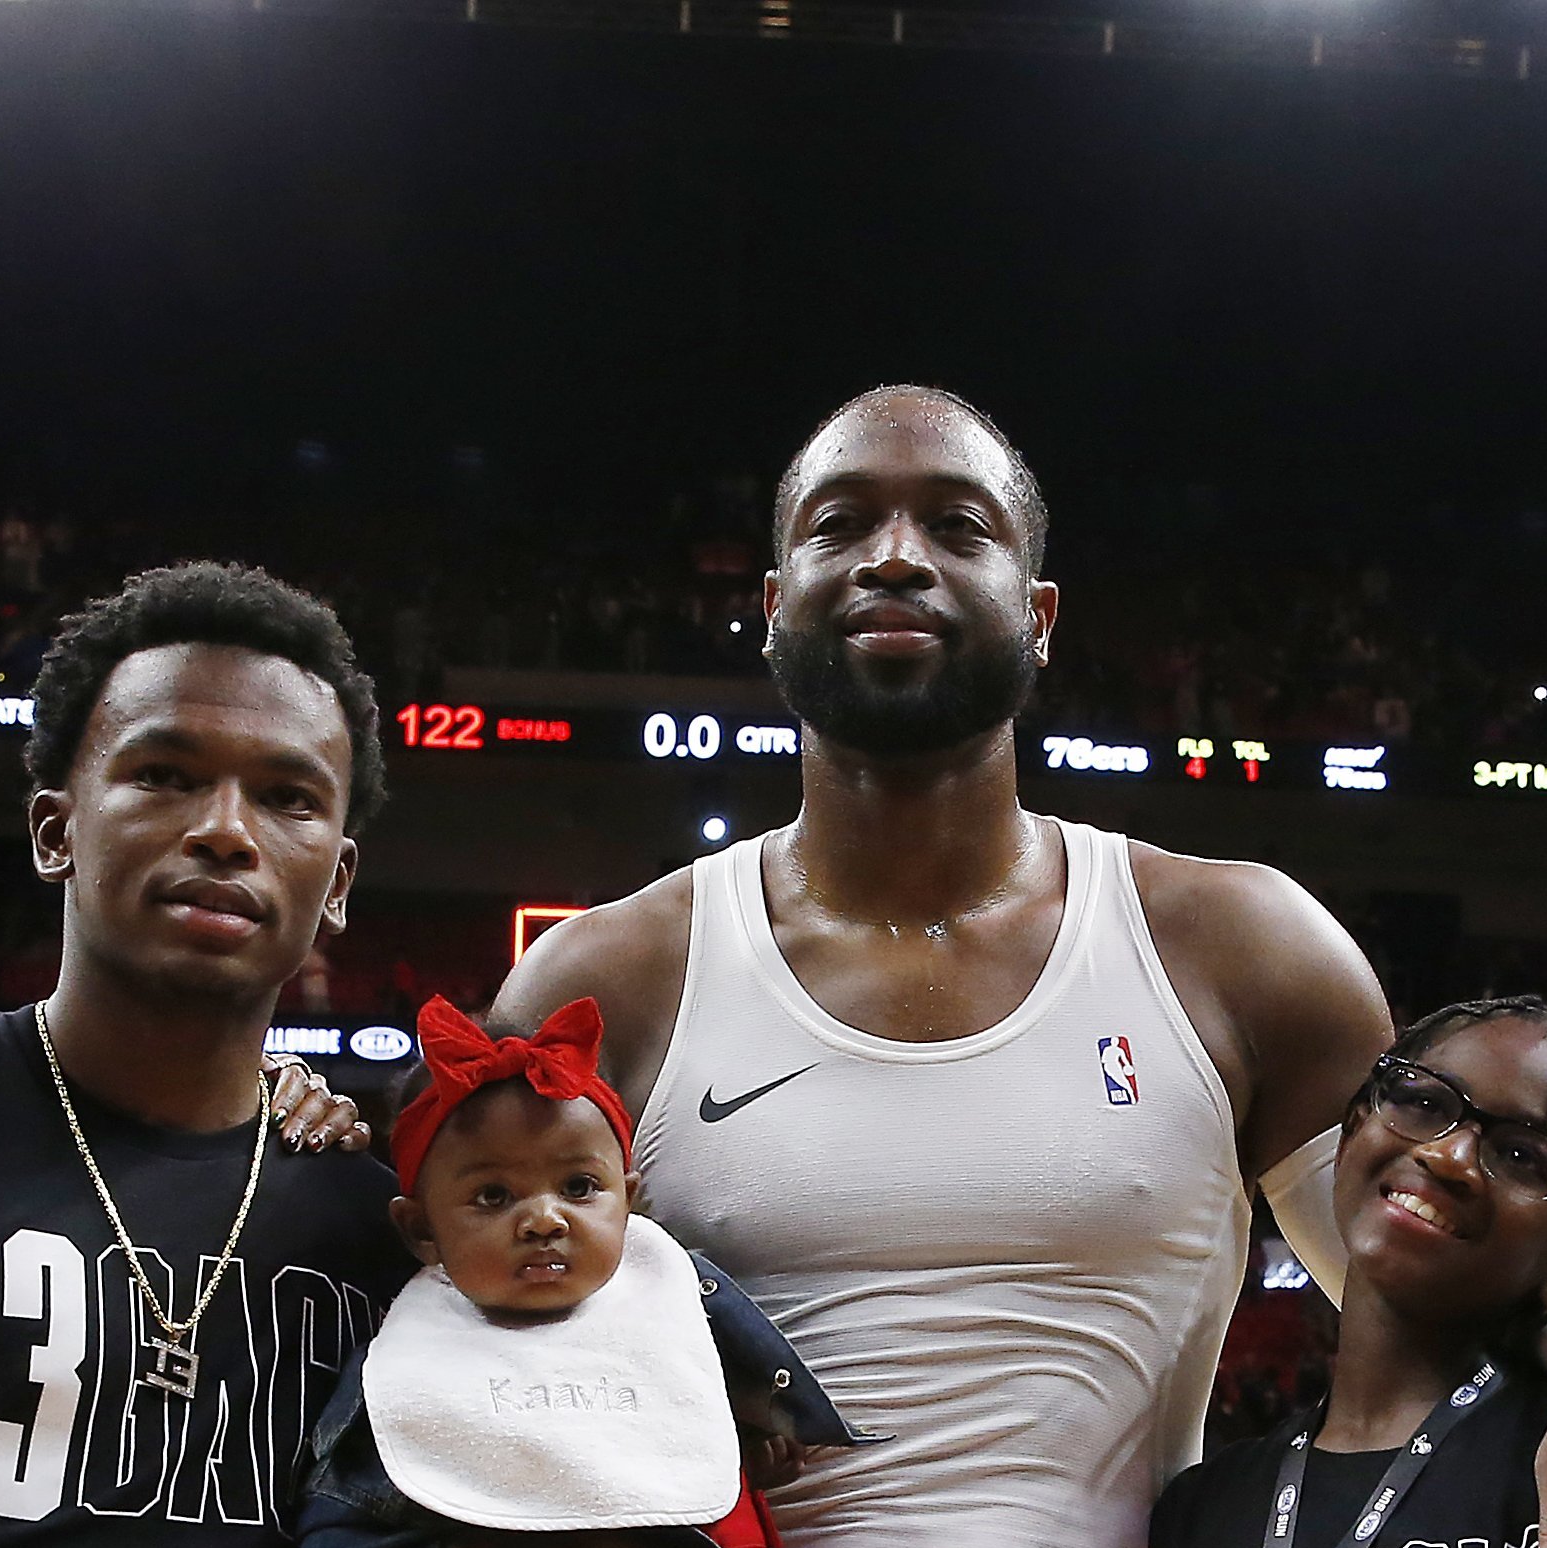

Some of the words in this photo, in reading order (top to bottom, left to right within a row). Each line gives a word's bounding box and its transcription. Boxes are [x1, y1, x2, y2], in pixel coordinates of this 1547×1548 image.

[396, 703, 485, 748] 122
[497, 718, 571, 741] BONUS
[643, 712, 722, 760] 0.0
[736, 725, 799, 756] QTR
[1043, 735, 1149, 773] 76ers
[1473, 760, 1532, 789] 3-PT
[1473, 1362, 1496, 1388] SUN
[488, 1376, 640, 1415] Kaavia
[1373, 1487, 1396, 1512] SUN
[1274, 1514, 1290, 1537] SUN
